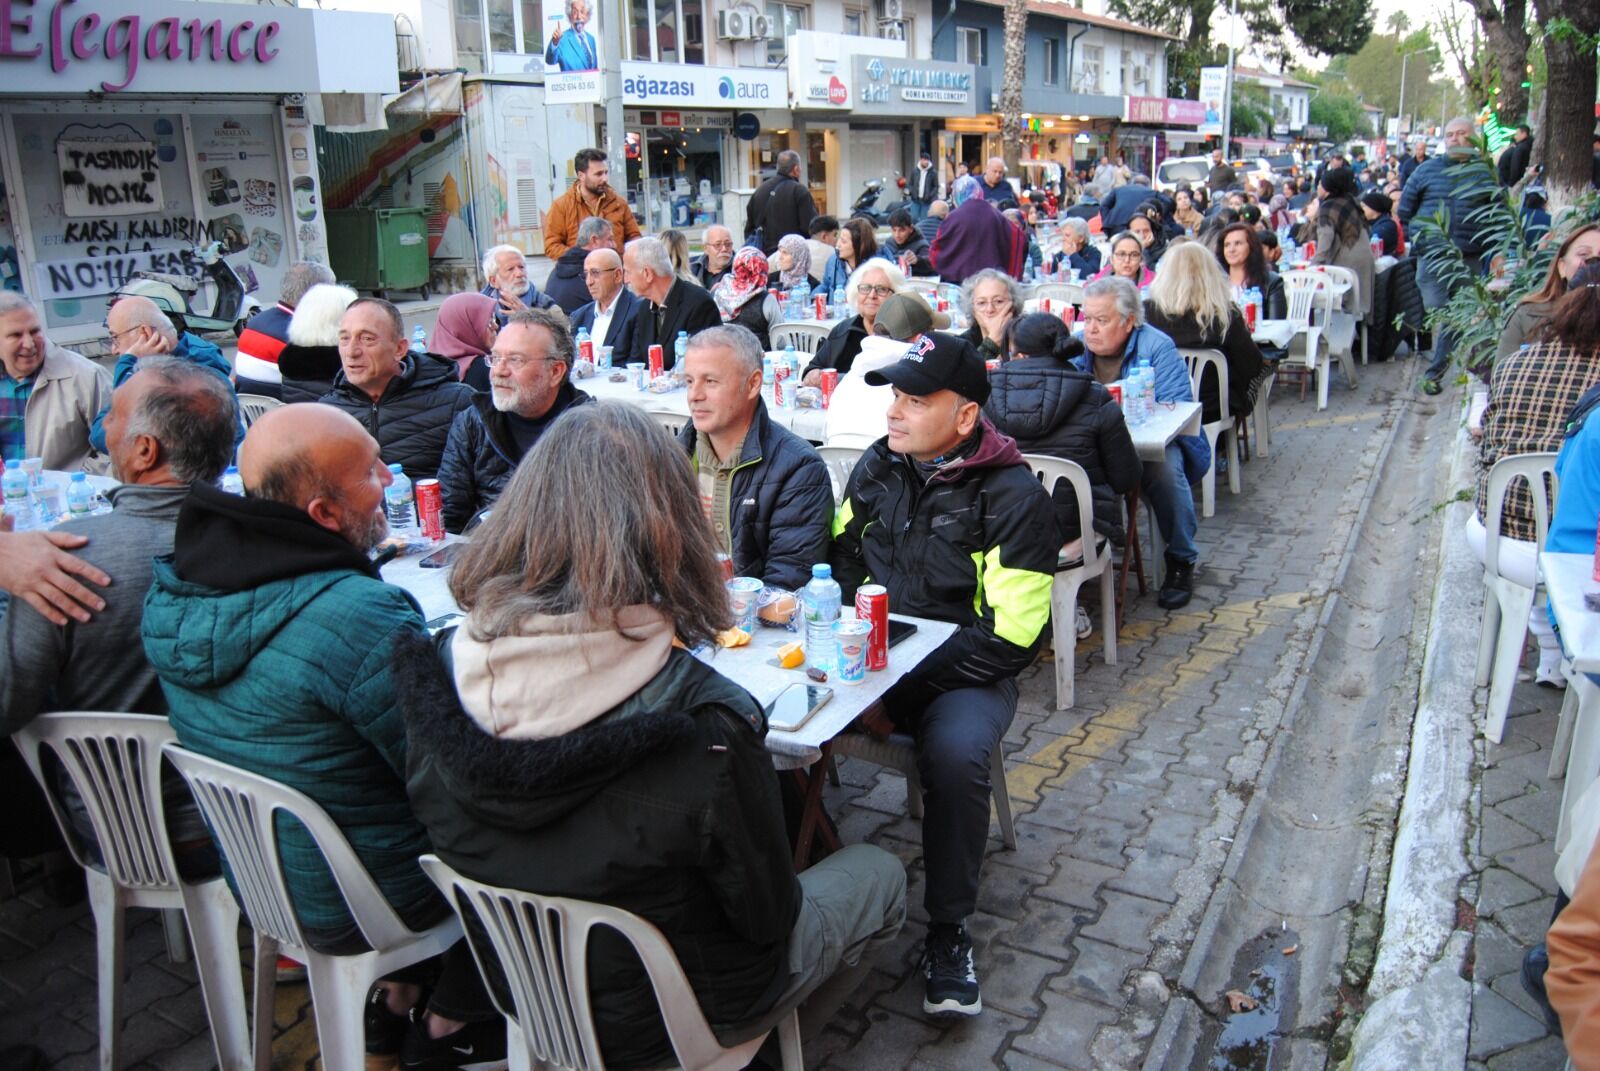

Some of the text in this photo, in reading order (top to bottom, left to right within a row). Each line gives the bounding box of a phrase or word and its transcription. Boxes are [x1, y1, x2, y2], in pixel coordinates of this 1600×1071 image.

[0, 0, 281, 93] Elegance
[624, 75, 695, 98] ağazası
[737, 82, 769, 99] aura
[830, 87, 847, 98] LOVE
[905, 89, 921, 98] HOME
[927, 91, 943, 99] HOTEL
[944, 92, 967, 101] CONCEPT
[707, 116, 732, 126] PHILIPS
